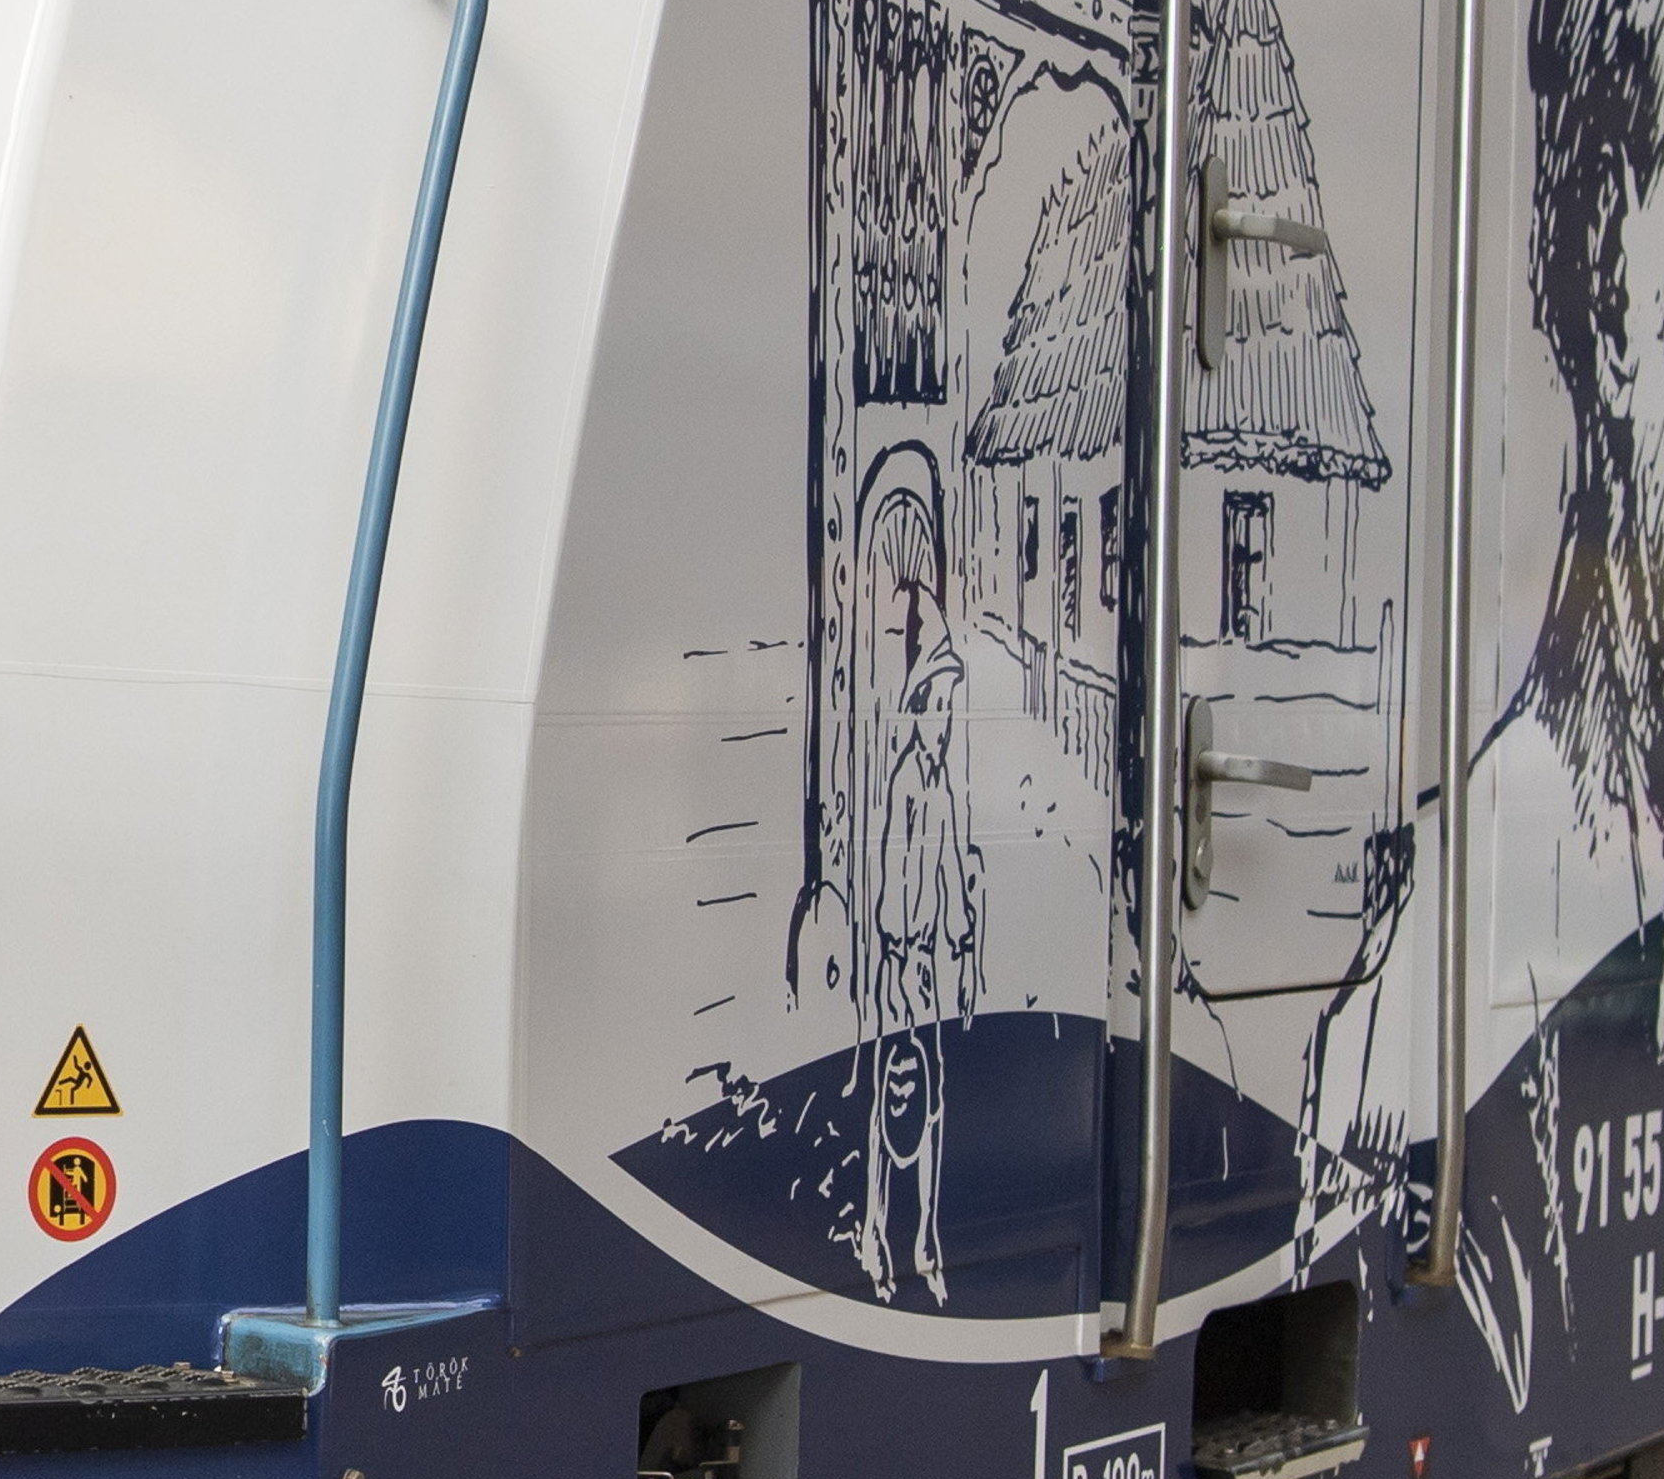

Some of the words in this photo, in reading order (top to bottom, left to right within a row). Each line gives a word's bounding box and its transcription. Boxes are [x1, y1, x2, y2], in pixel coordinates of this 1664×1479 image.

[1574, 1121, 1611, 1235] 91
[1623, 1109, 1663, 1221] 55
[418, 1371, 463, 1400] MÁTÉ
